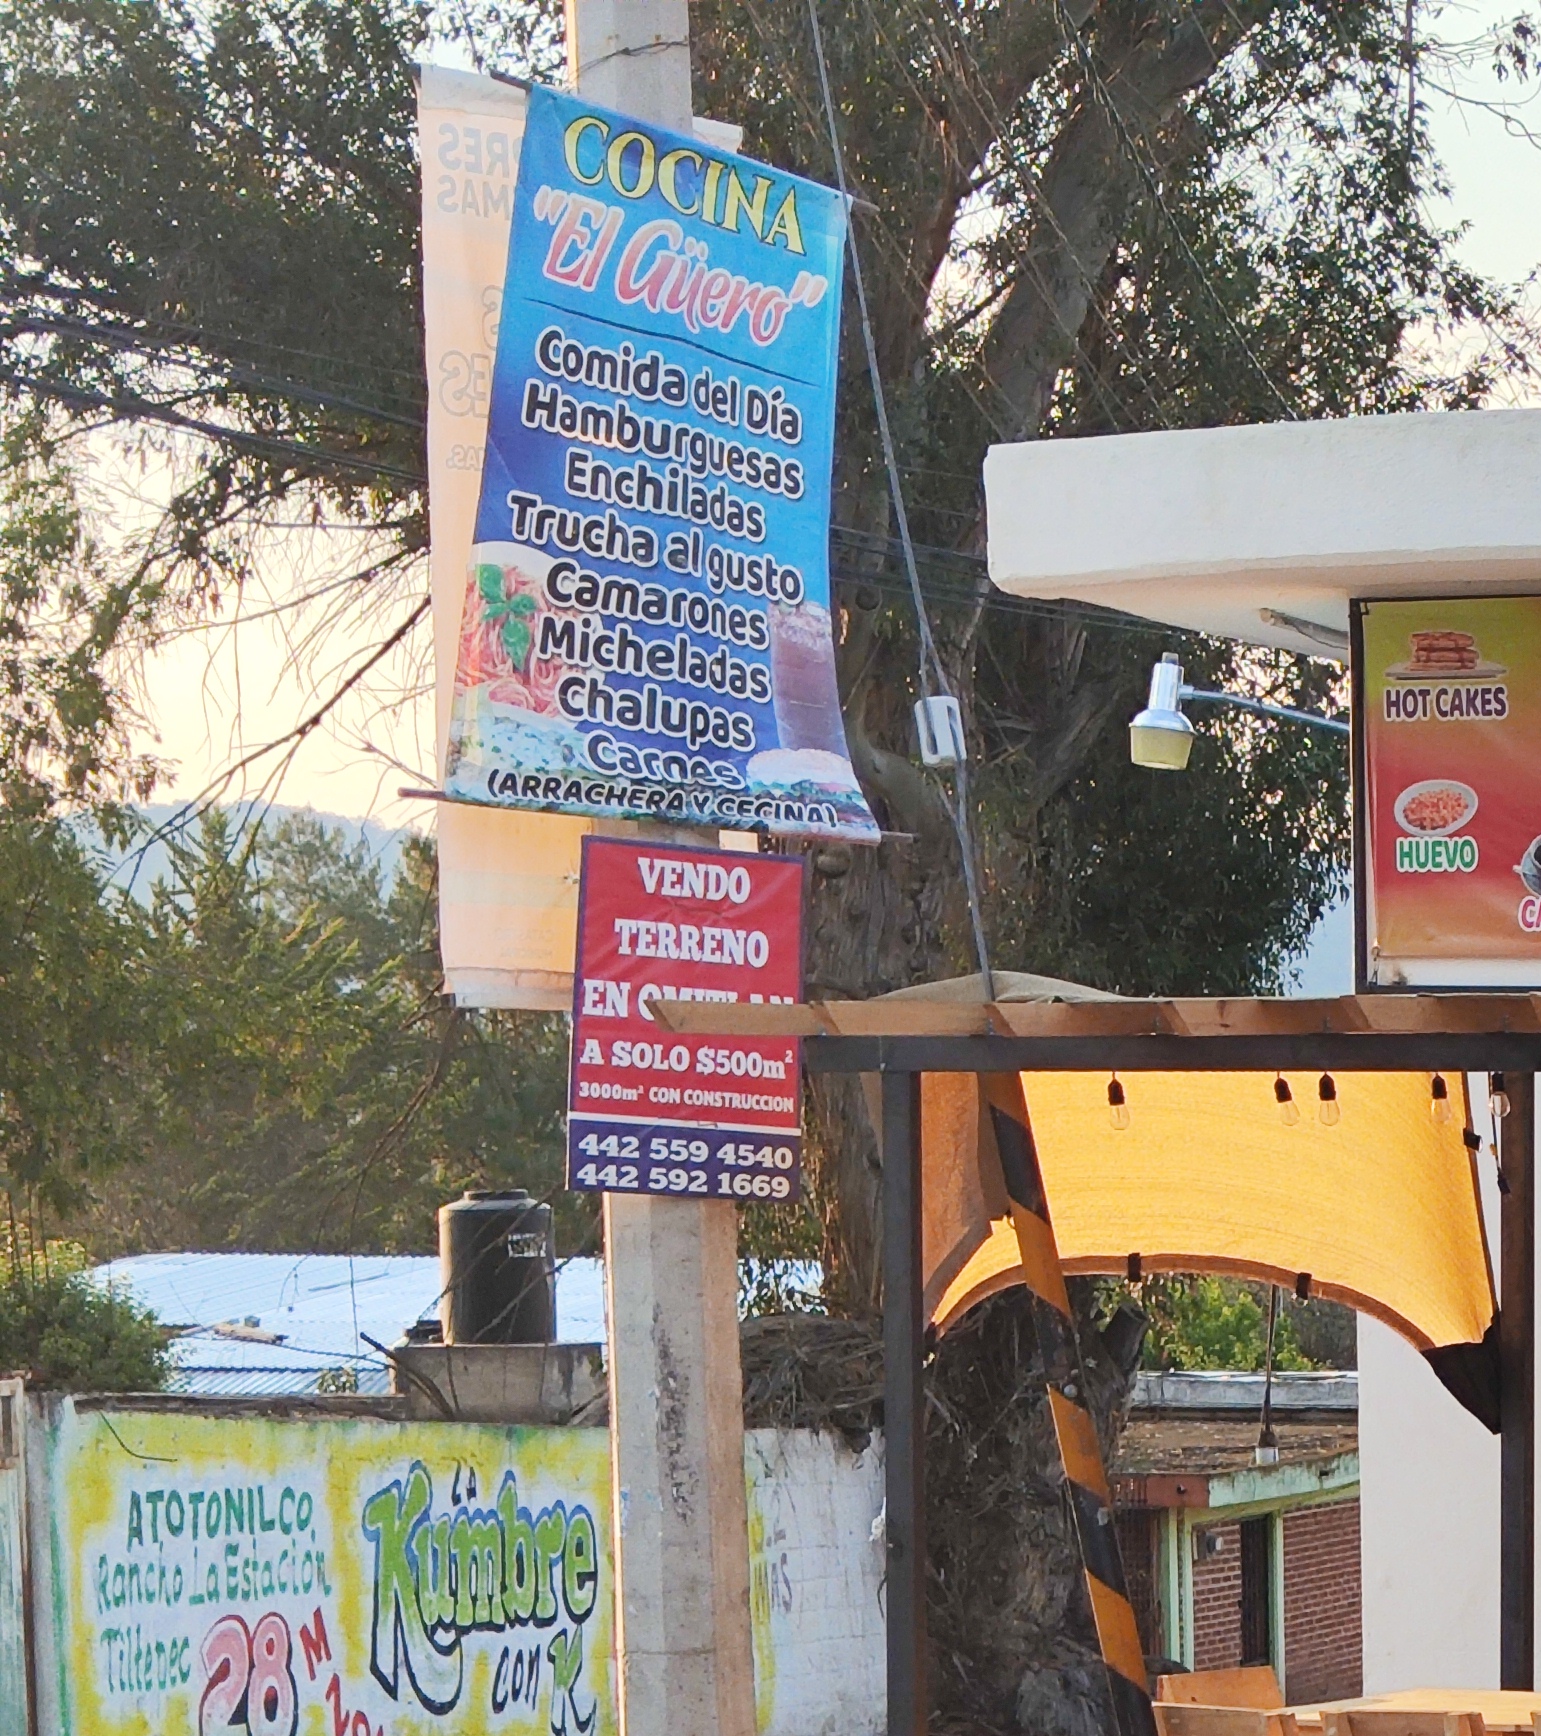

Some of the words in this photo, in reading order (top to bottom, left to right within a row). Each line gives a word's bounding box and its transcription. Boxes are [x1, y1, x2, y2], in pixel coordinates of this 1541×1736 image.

[564, 115, 808, 256] COCINA
[533, 185, 625, 292] "El
[614, 218, 828, 346] Güero"
[536, 329, 688, 404] Comida
[693, 367, 738, 425] del
[746, 388, 801, 442] Día
[524, 382, 803, 496] Hamburguesas
[566, 450, 764, 539] Enchiladas
[509, 494, 656, 564] Trucha
[667, 530, 701, 574] al
[708, 545, 802, 602] gusto
[545, 562, 770, 648] Camarones
[538, 615, 771, 701] Micheladas
[556, 675, 754, 750] Chalupas
[1385, 688, 1432, 721] HOT
[1435, 686, 1508, 719] CAKES
[487, 768, 687, 815] (ARRACHERA
[690, 792, 711, 816] Y
[716, 795, 838, 829] CECINA)
[637, 856, 752, 905] VENDO
[1397, 838, 1479, 871] HUEVO
[614, 917, 771, 969] TERRENO
[581, 978, 632, 1018] EN
[579, 1038, 605, 1066] A
[611, 1039, 691, 1073] SOLO
[648, 1086, 682, 1105] CON
[683, 1088, 795, 1114] CONSTRUCCION
[576, 1162, 640, 1189] 442
[648, 1167, 708, 1194] 592
[717, 1172, 791, 1200] 1669
[577, 1132, 641, 1160] 442
[650, 1137, 709, 1164] 559
[716, 1143, 794, 1170] 4540
[97, 1540, 184, 1615] Rancho
[362, 1459, 599, 1716] Kumbre
[491, 1643, 541, 1714] con
